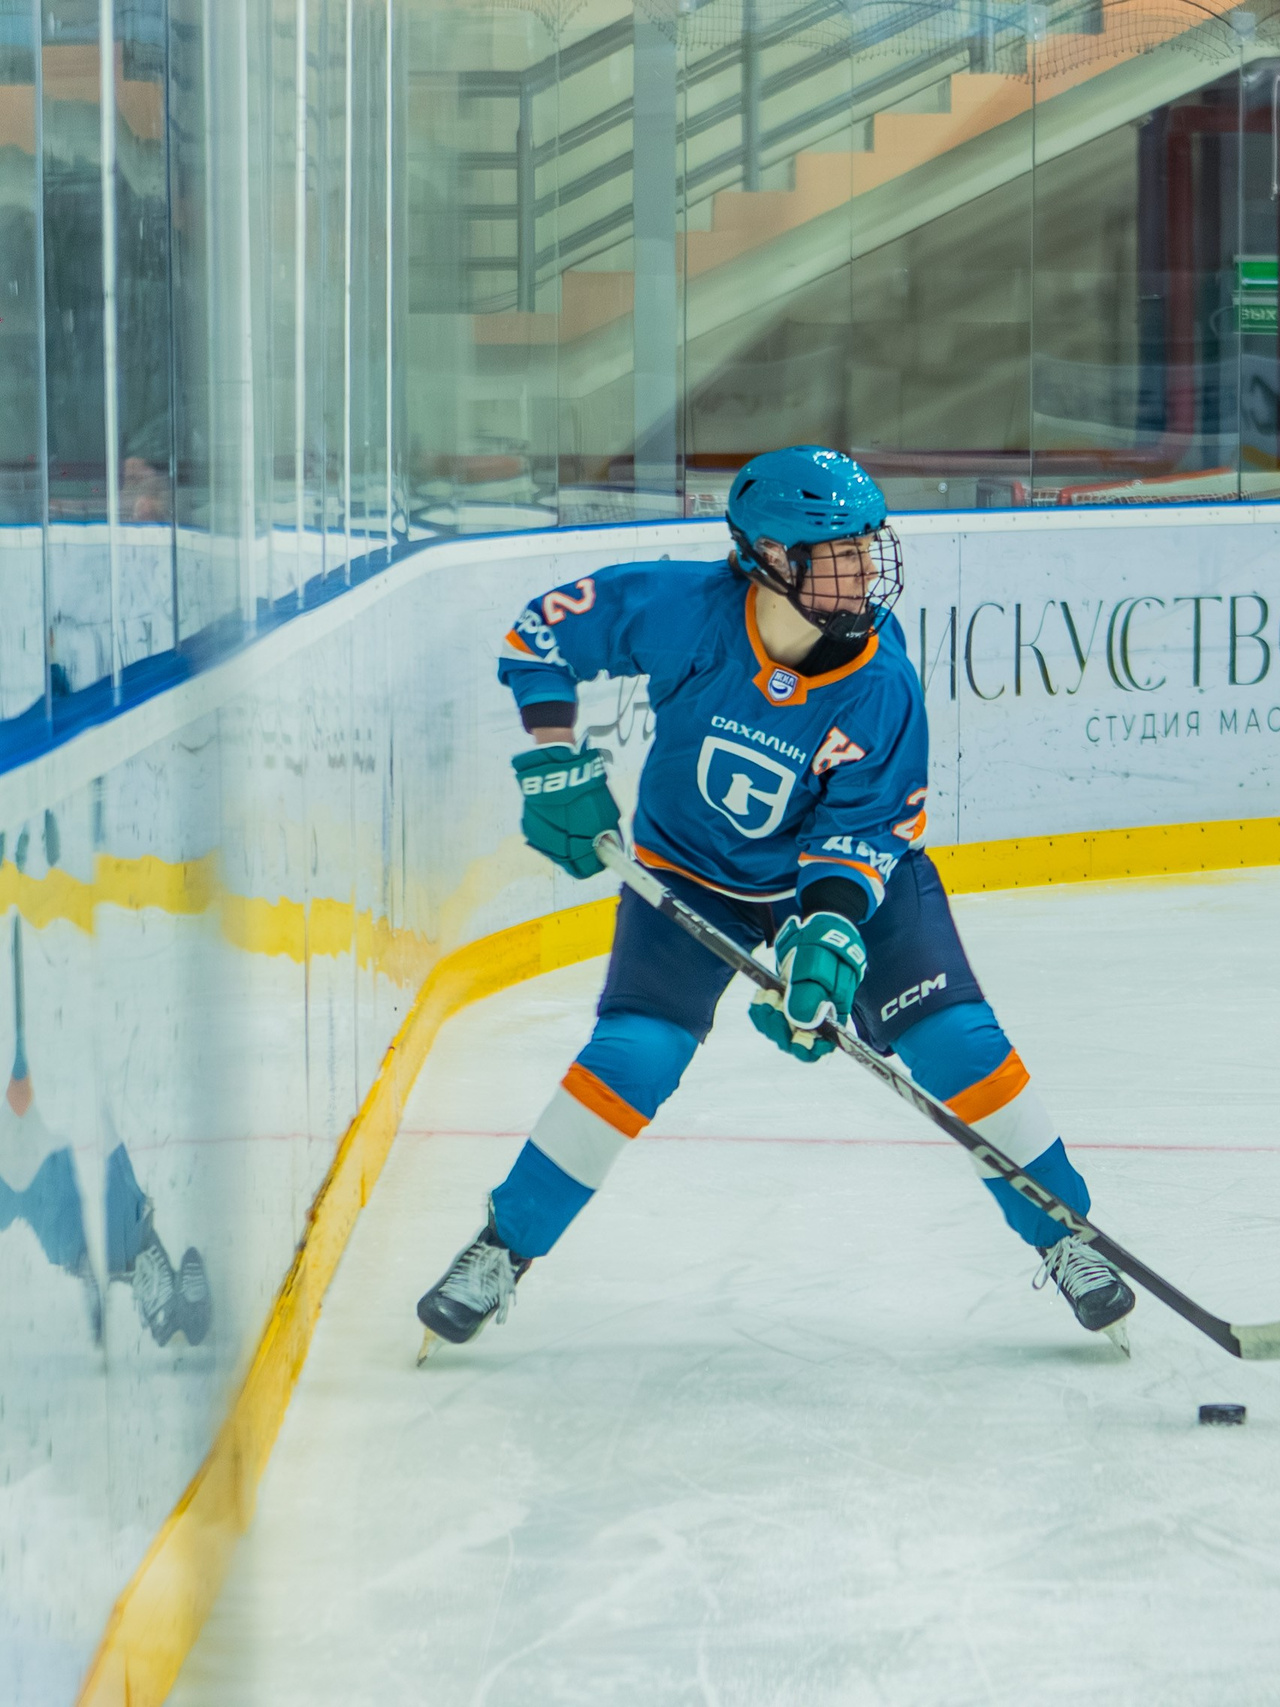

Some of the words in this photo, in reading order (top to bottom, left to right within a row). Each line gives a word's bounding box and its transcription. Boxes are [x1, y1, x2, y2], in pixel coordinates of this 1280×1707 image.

[542, 578, 597, 625] 2
[711, 715, 807, 764] САХАЛИН
[1085, 710, 1201, 745] СТУДИЯ
[880, 973, 947, 1022] CCM
[973, 1144, 1100, 1243] CCM
